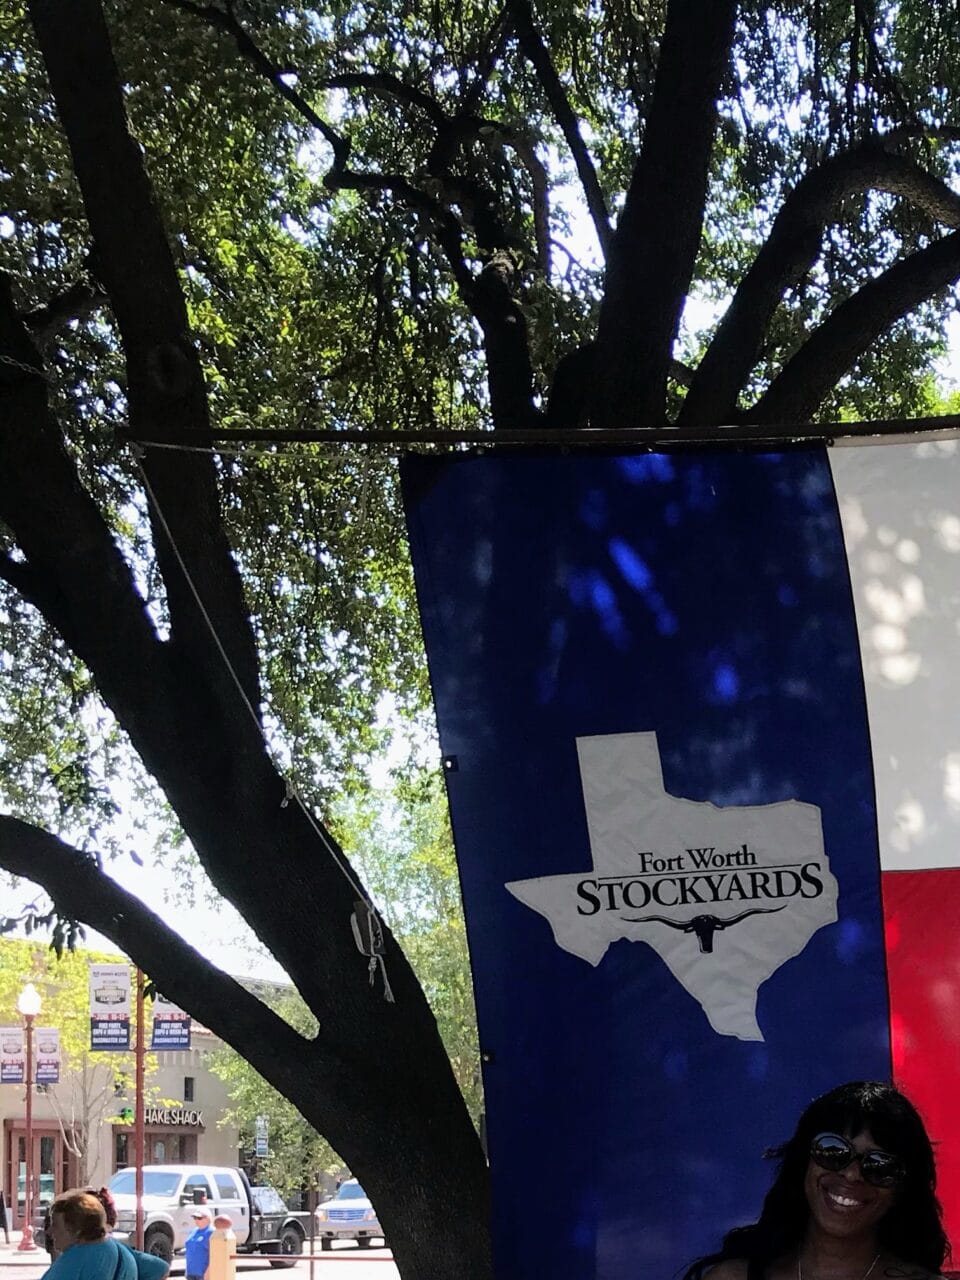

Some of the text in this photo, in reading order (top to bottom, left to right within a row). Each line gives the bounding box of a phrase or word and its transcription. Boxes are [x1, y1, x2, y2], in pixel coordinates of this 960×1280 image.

[638, 844, 758, 873] Fort Worth
[576, 862, 824, 916] STOCKYARDS
[144, 1109, 206, 1128] HAKE SHACK
